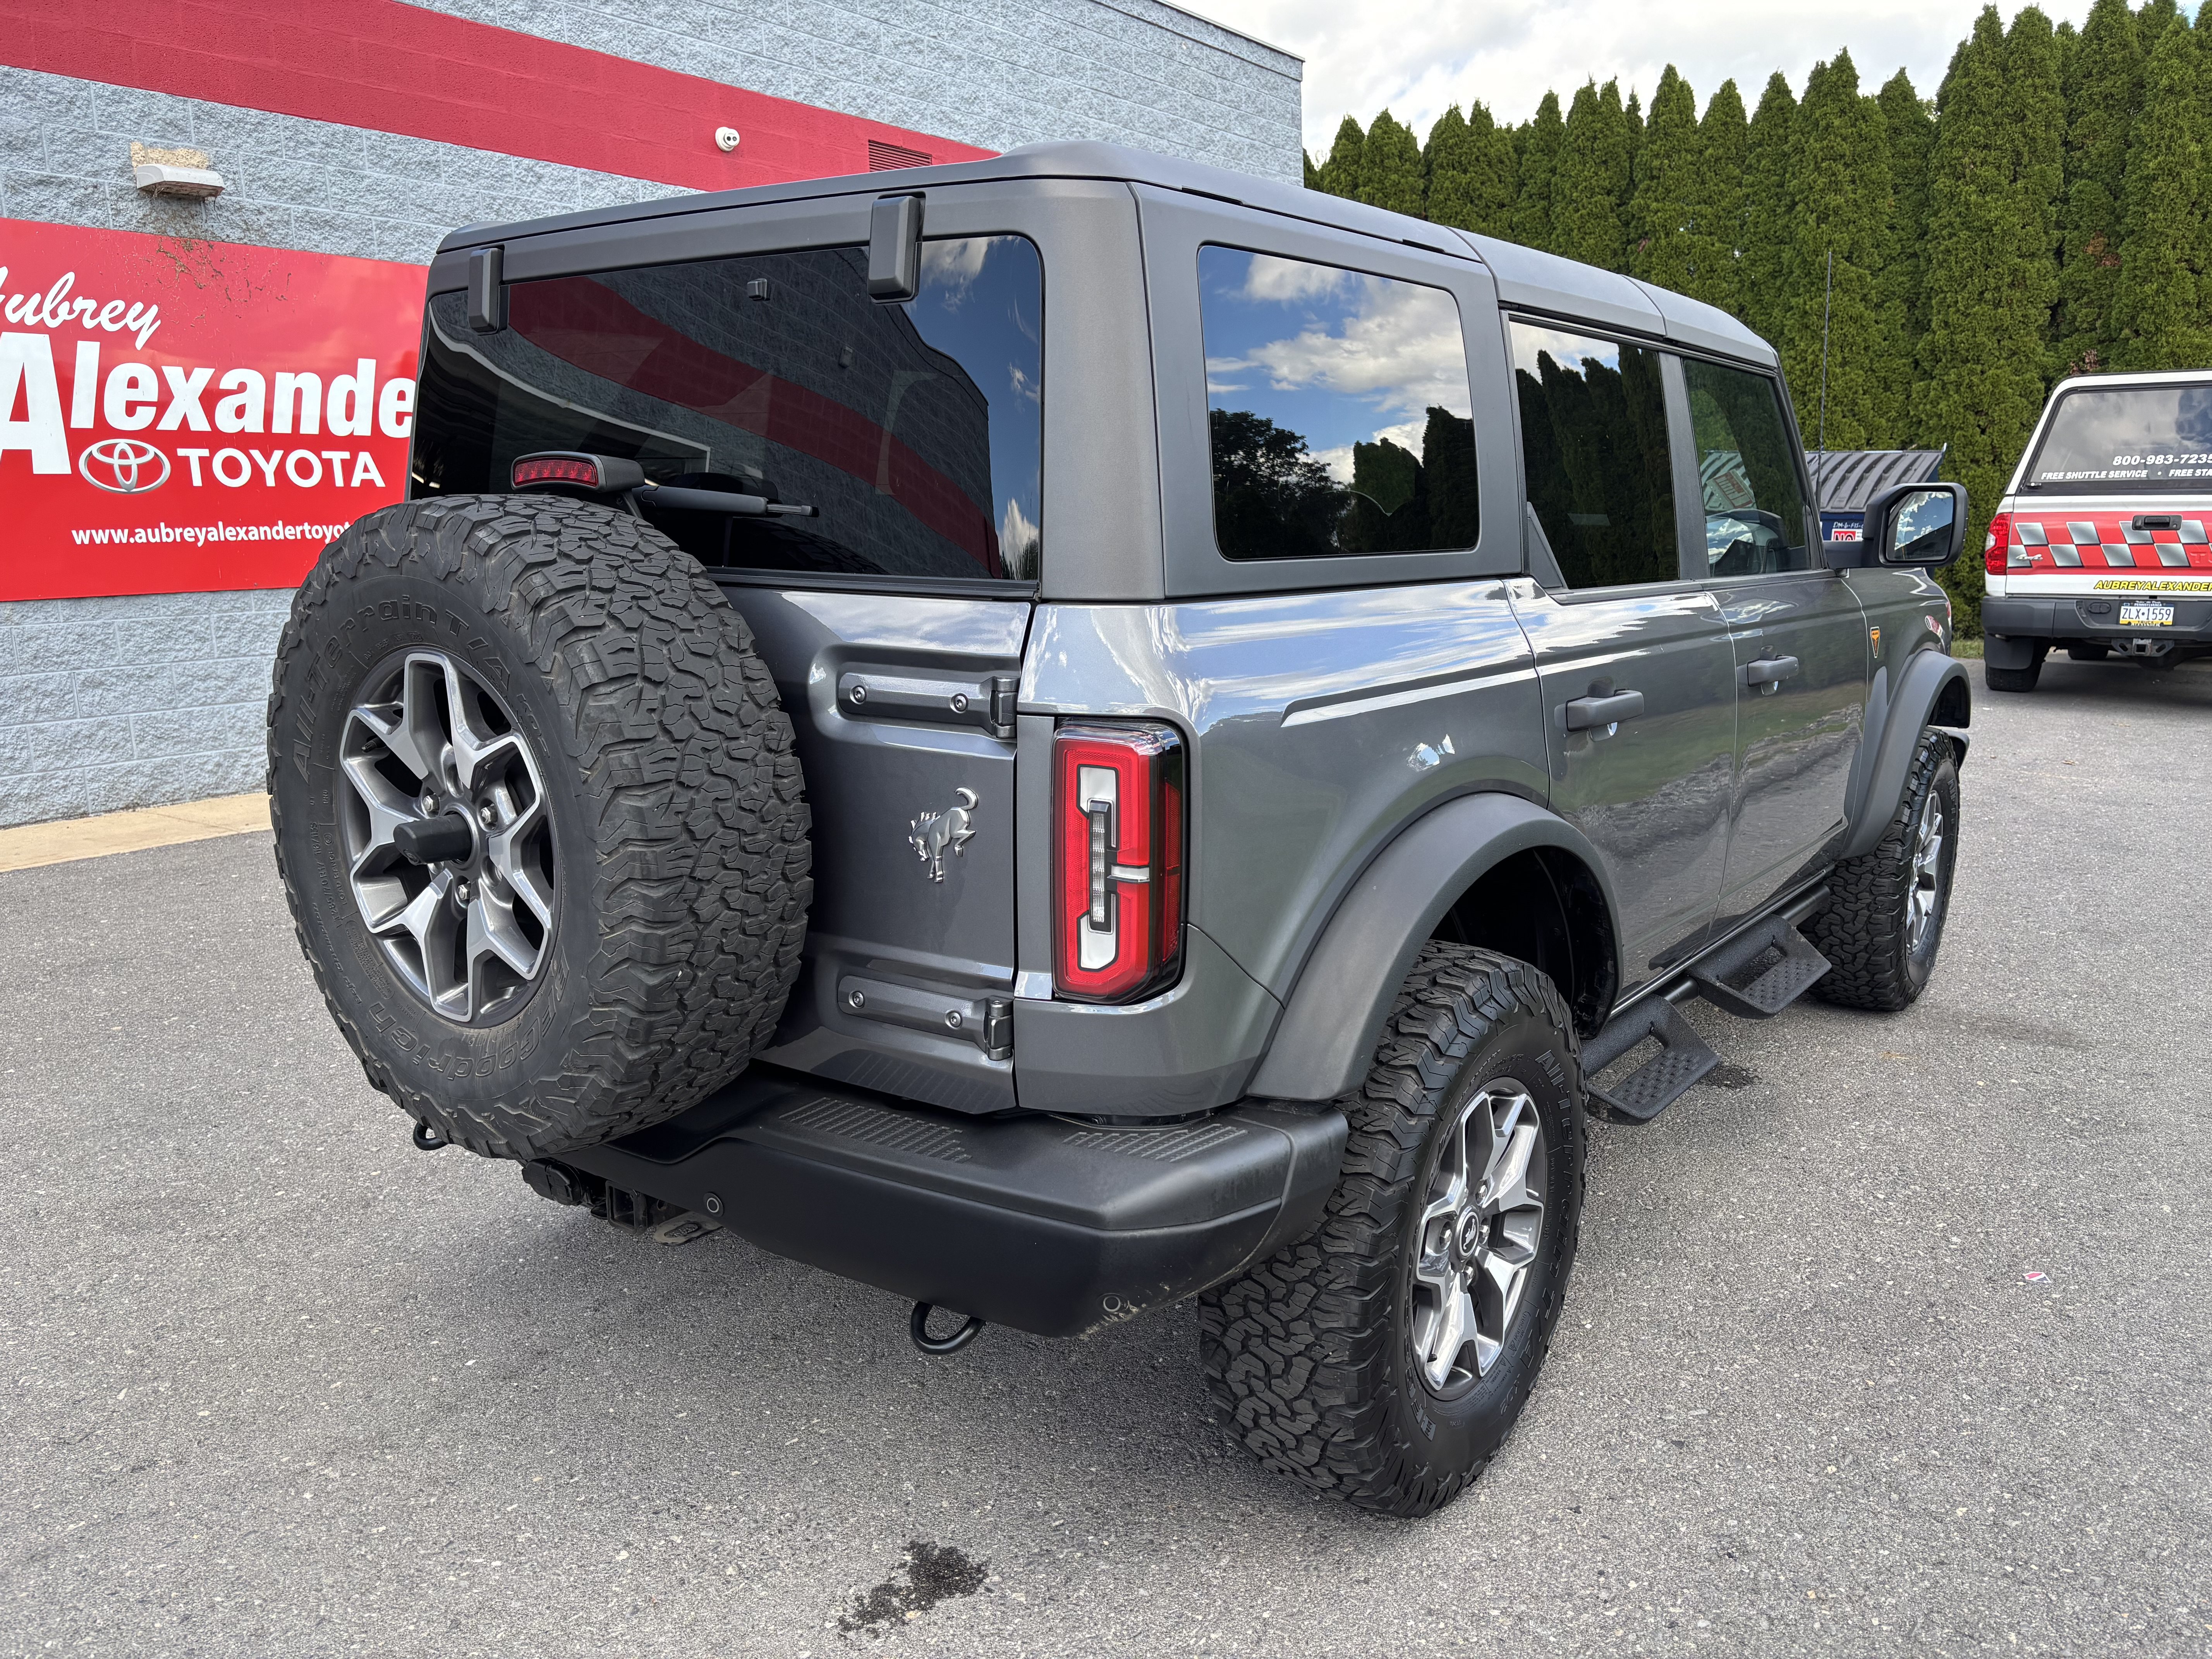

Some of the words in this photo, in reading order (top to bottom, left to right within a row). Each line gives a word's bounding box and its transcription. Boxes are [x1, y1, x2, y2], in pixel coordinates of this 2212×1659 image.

[0, 331, 416, 475] Alexande
[177, 448, 385, 487] TOYOTA
[2041, 471, 2065, 480] FREE
[2066, 471, 2107, 479] SHUTTLE
[2108, 469, 2148, 478] SERVICE
